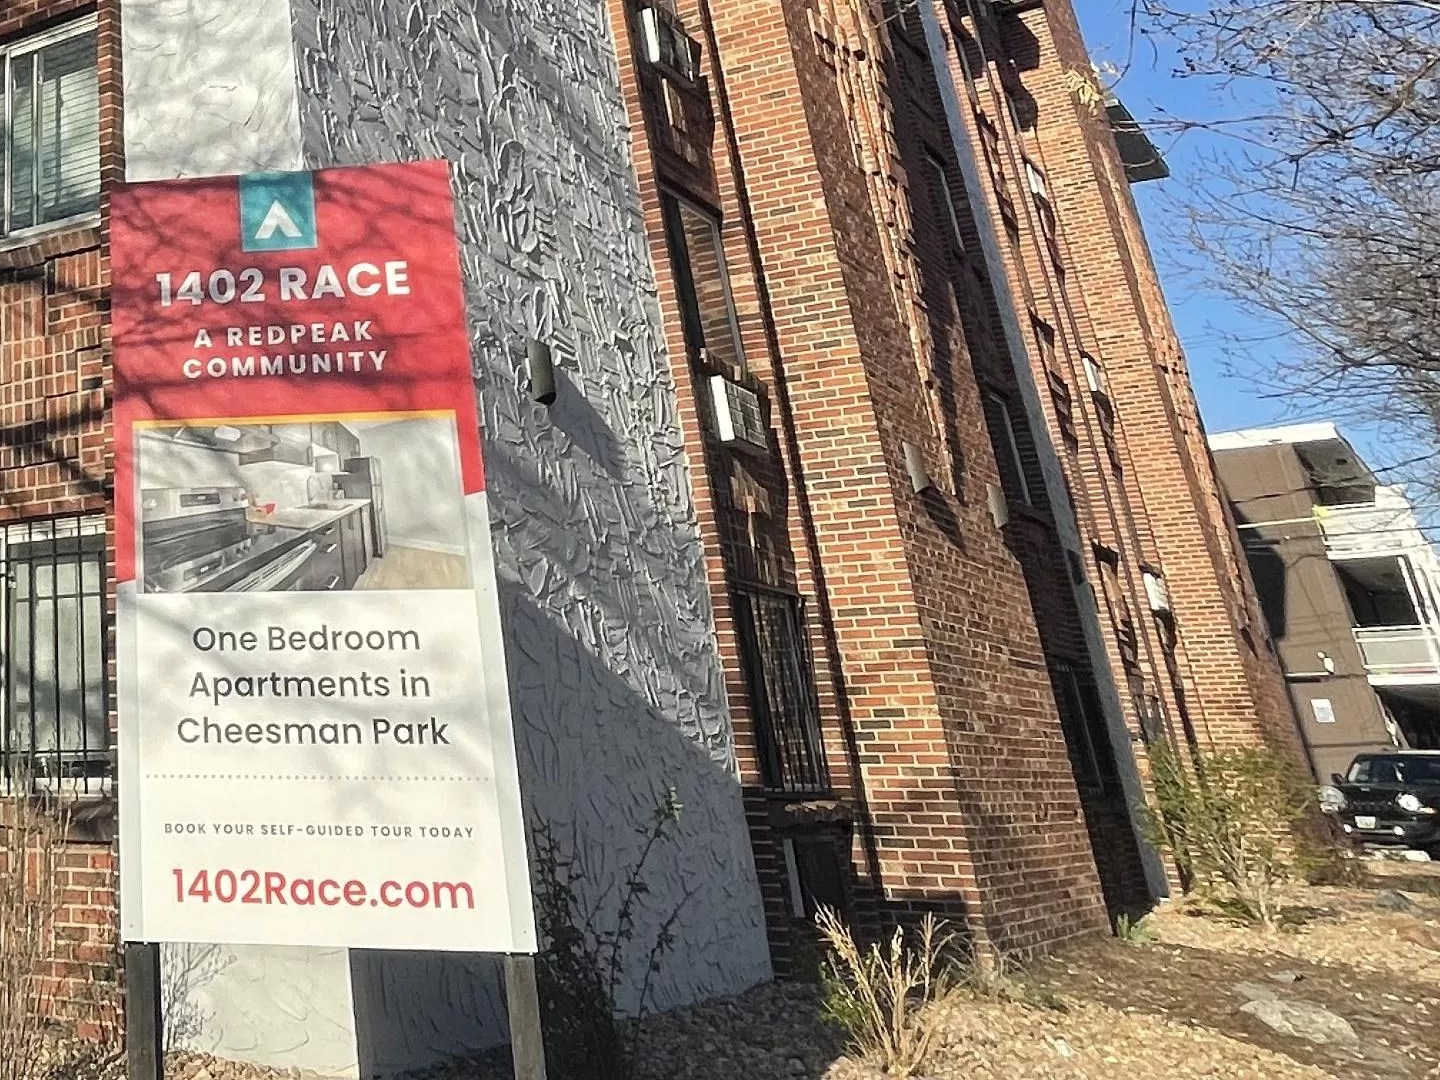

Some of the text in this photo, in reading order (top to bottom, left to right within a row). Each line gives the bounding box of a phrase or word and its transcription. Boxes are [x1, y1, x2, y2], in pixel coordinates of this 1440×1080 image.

[155, 260, 411, 307] 1402 RACE
[193, 320, 373, 349] A REDPEAK
[181, 349, 388, 379] COMMUNITY
[192, 624, 421, 652] One Bedroom
[189, 668, 431, 706] Apartments in
[176, 716, 451, 745] Cheesman Park
[164, 823, 474, 839] BOOK YOUR SELF-GUIDED TOUR TODAY
[172, 868, 475, 909] 1402Race.com
